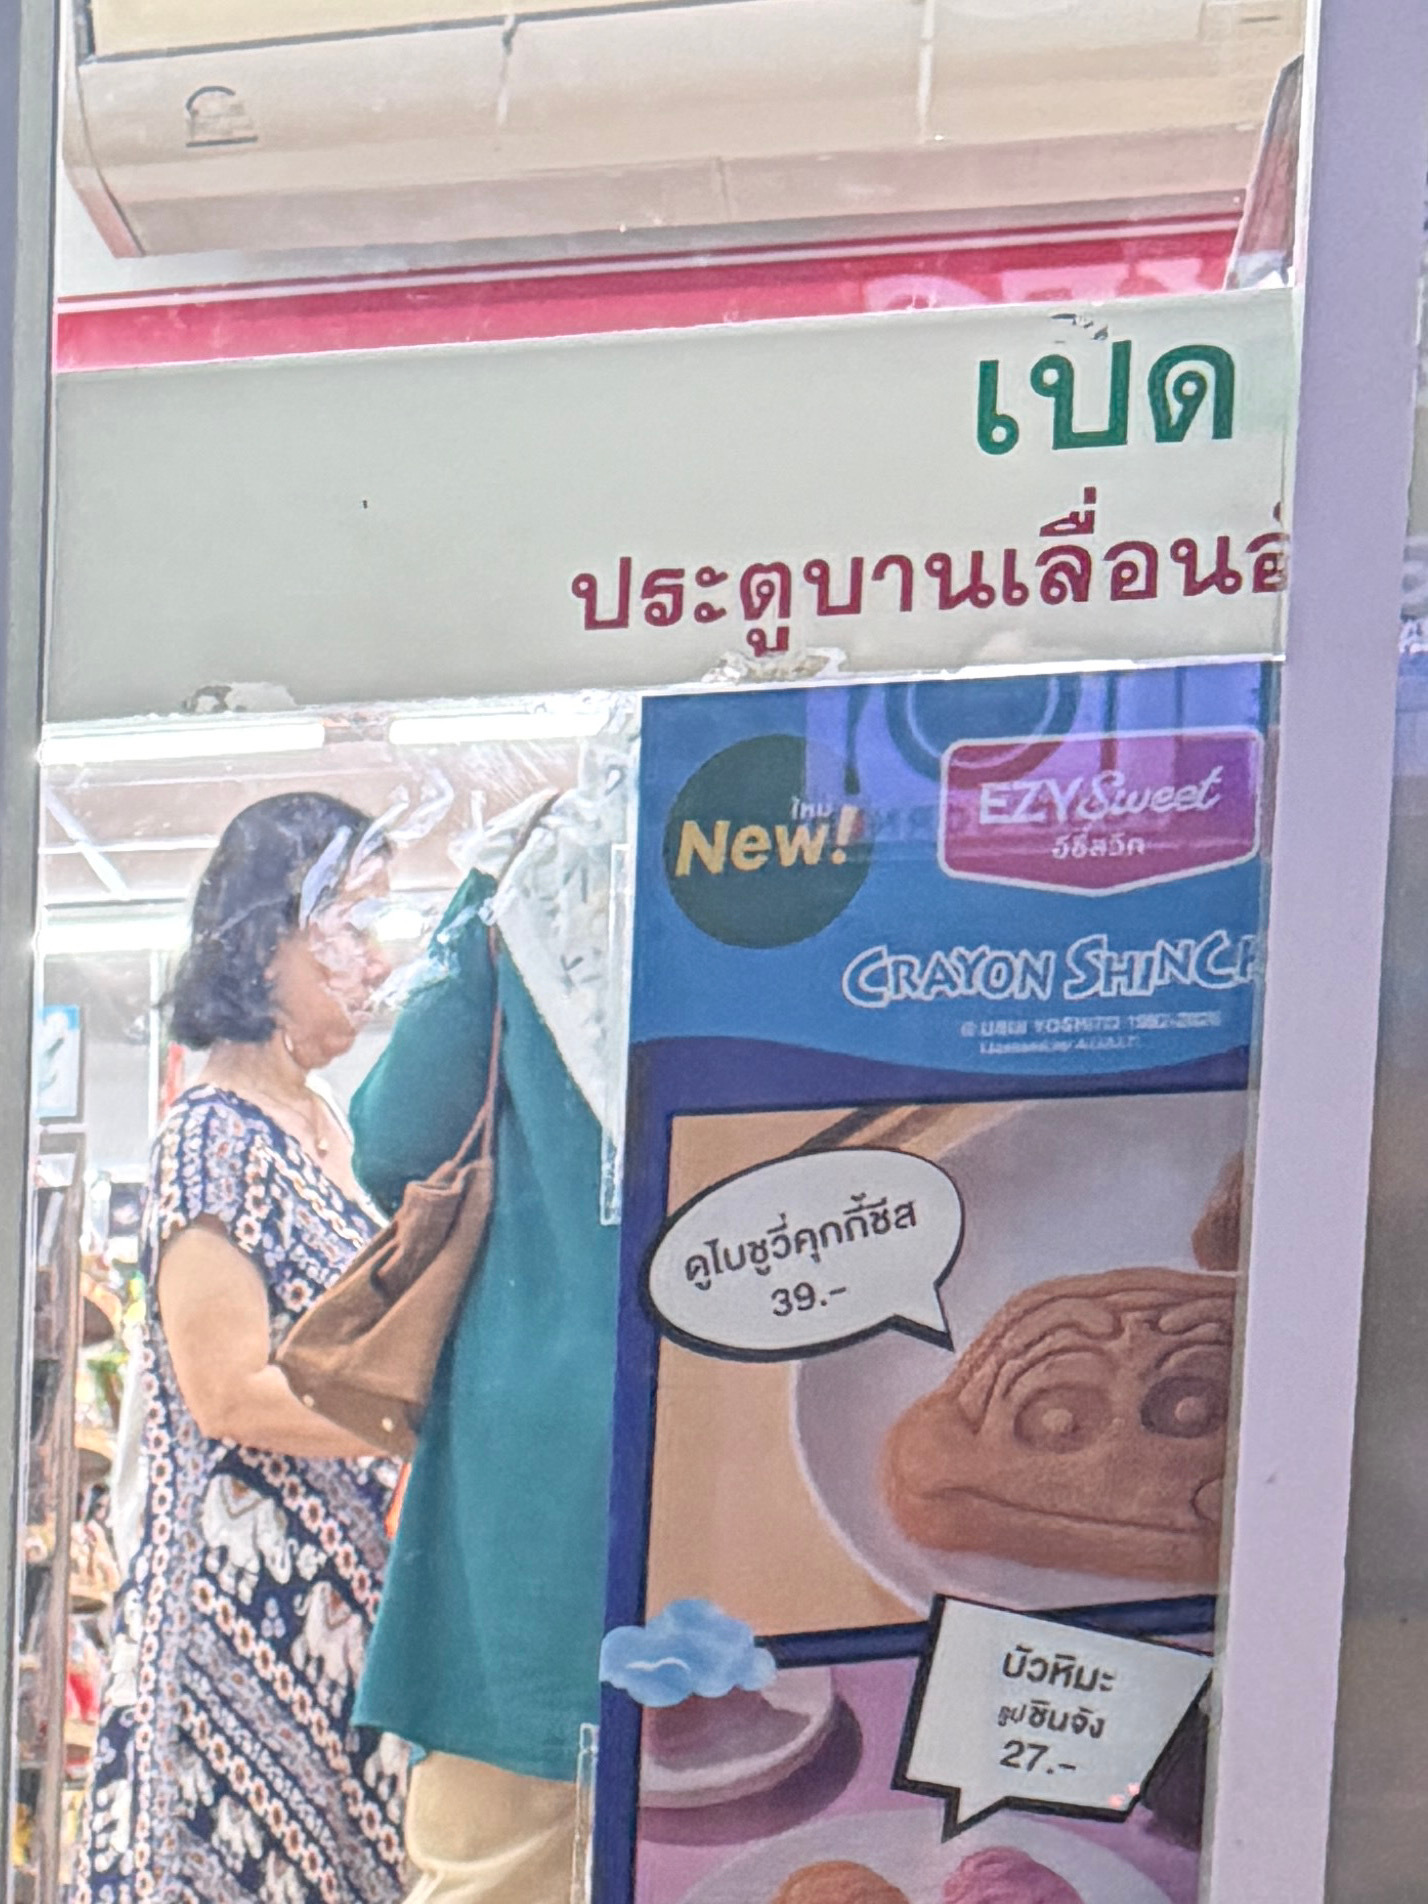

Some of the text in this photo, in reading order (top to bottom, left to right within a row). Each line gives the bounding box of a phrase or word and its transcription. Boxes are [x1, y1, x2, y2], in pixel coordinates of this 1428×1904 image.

[976, 338, 1236, 456] เปด
[571, 486, 1290, 658] ประตูบานเลื่อนอ
[979, 765, 1225, 825] EZY Sweet
[674, 804, 859, 878] New!
[841, 942, 1057, 1010] CRAYON
[684, 1191, 918, 1291] ดูไบชูวี่คุกกี้ชีส
[770, 1282, 847, 1317] 39.-
[1002, 1644, 1116, 1692] บัวหิมะ
[999, 1739, 1077, 1775] 27.-
